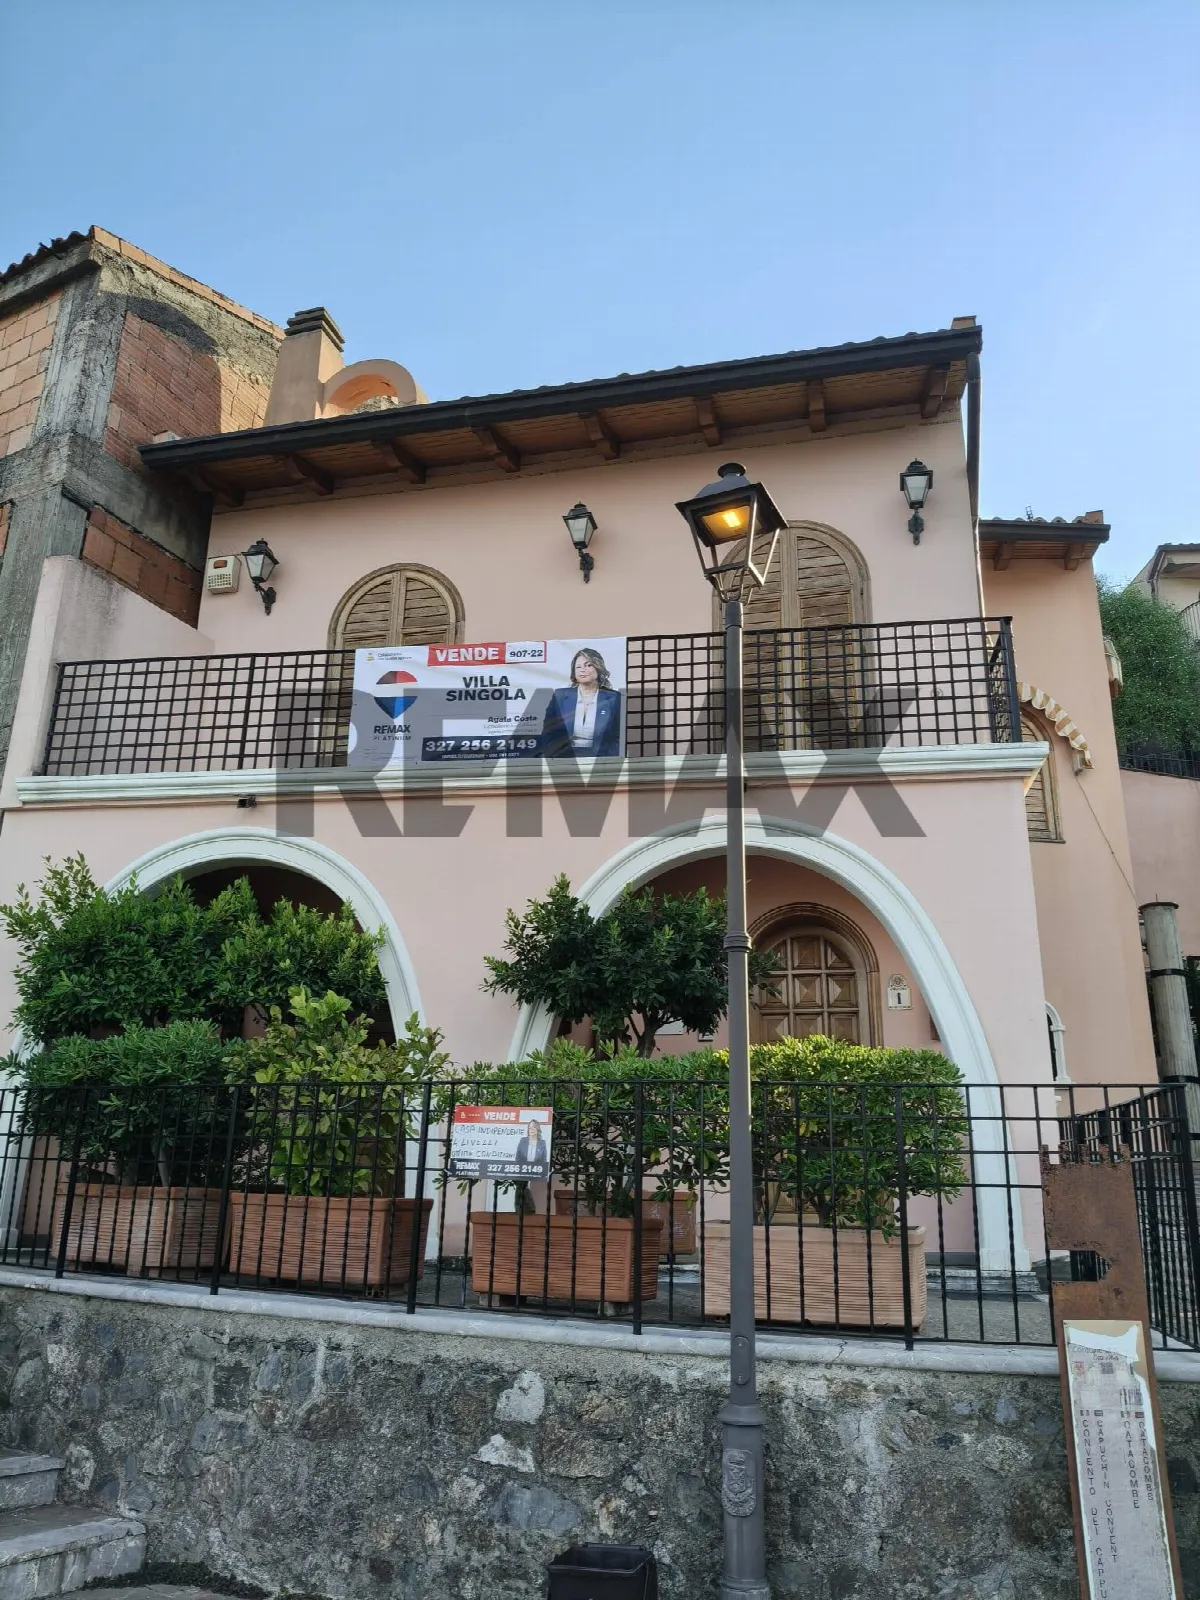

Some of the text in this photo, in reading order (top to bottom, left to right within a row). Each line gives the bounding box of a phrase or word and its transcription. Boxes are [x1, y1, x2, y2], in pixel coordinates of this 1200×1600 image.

[436, 648, 543, 661] VENDE 907-22
[463, 676, 510, 688] VILLA
[446, 689, 526, 701] SINGOLA
[374, 725, 411, 734] REMAX
[426, 739, 537, 751] 327 256 2149
[484, 1112, 516, 1120] VENDE
[455, 1125, 475, 1133] CASA
[1124, 1421, 1140, 1508] CATACOMBE
[1082, 1420, 1096, 1496] CONVENTO
[1091, 1507, 1099, 1536] DEI
[1097, 1420, 1117, 1562] CAPUCHIN CONVENT
